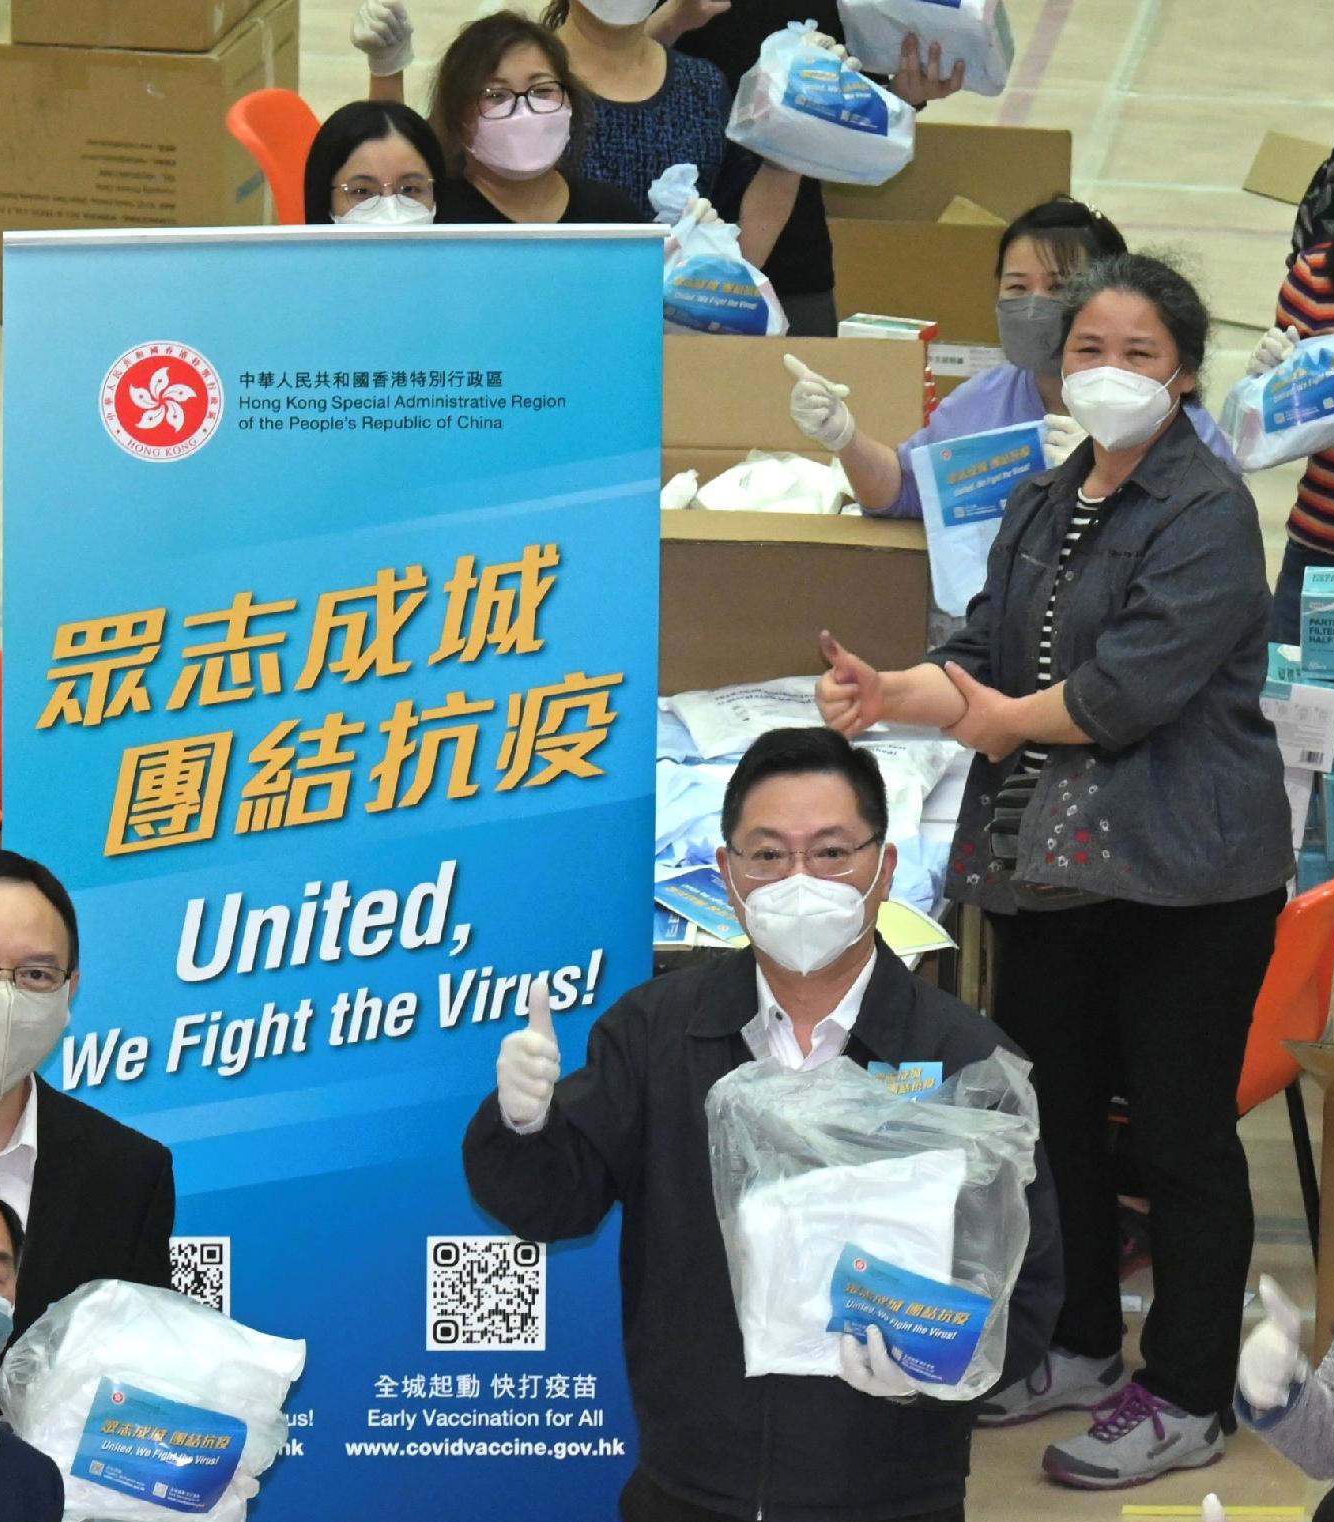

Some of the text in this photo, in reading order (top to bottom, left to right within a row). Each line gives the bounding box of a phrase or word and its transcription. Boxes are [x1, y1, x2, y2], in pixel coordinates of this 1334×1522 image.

[239, 370, 503, 389] 中華人民共和國香港特別行政區
[239, 394, 567, 413] Hong Kong Special Administrative Region
[238, 415, 503, 432] of the People's Republic of China
[127, 438, 197, 456] HONG KONG
[35, 542, 562, 730] 眾志成城
[103, 671, 624, 858] 團結抗疫
[174, 859, 471, 984] United,
[61, 948, 605, 1092] We Fight the Virus!
[373, 1373, 598, 1400] 全城起動 快打疫苗
[367, 1408, 417, 1431] Early
[422, 1408, 540, 1427] Vaccination
[545, 1408, 573, 1427] for
[578, 1408, 604, 1427] All
[345, 1437, 625, 1460] www.covidvaccine.gov.hk
